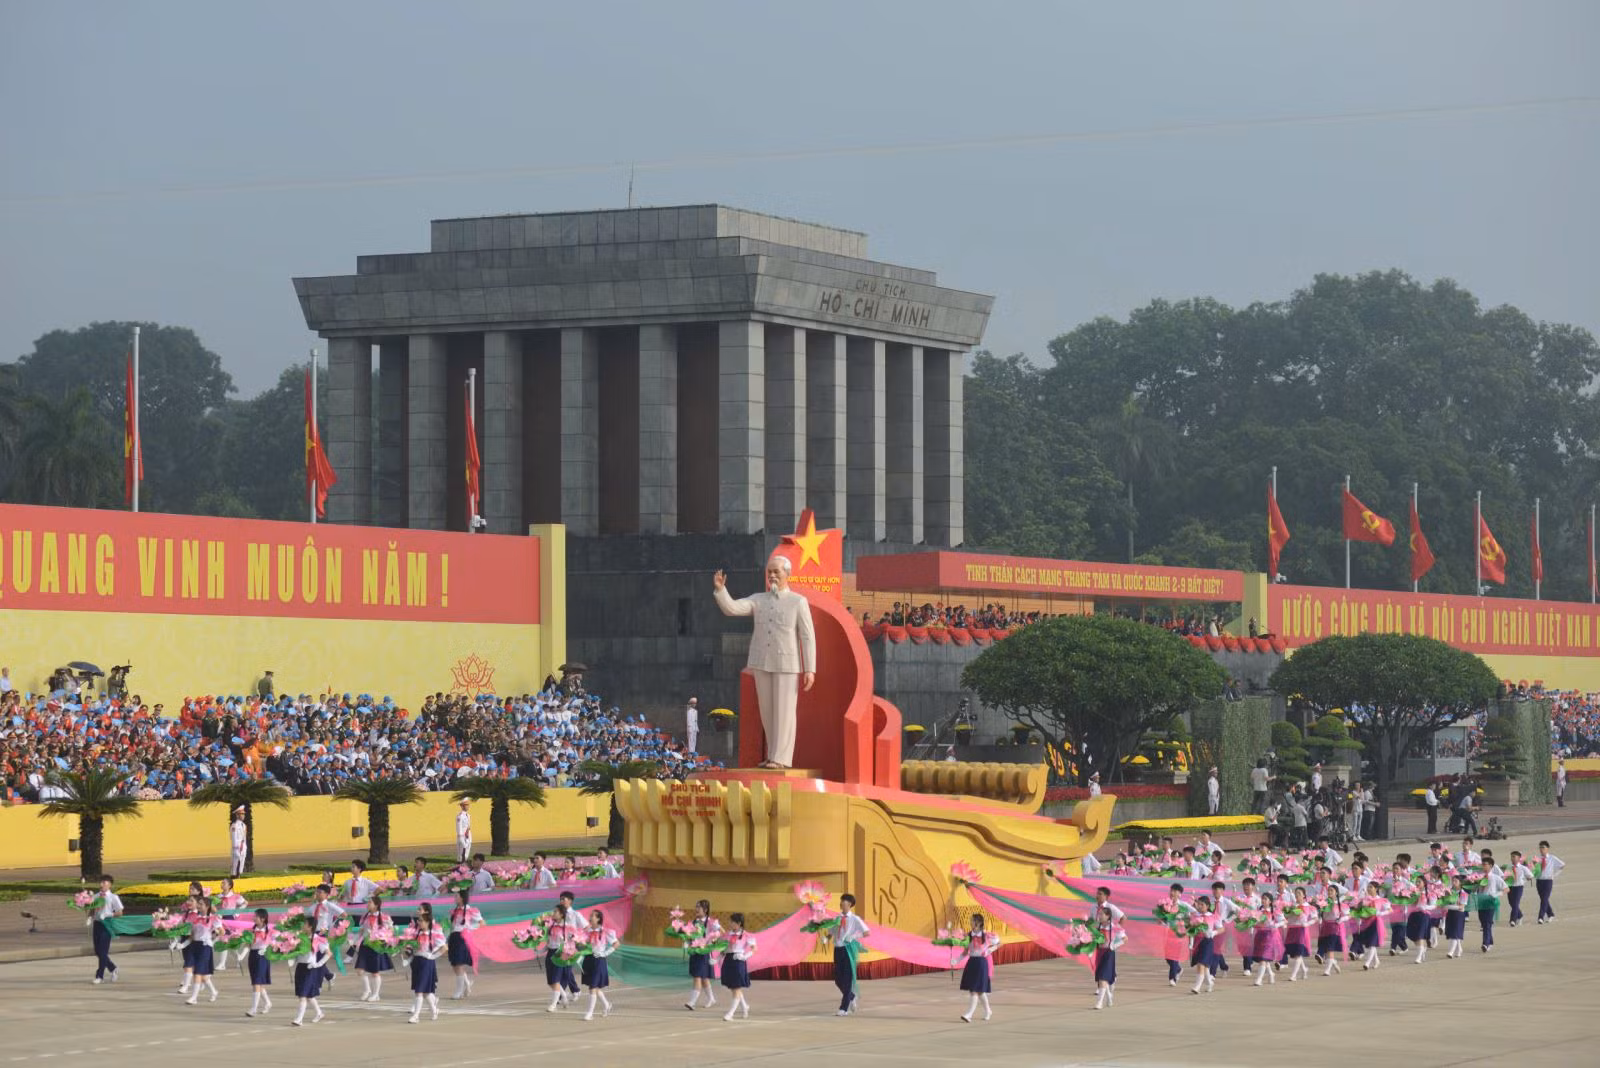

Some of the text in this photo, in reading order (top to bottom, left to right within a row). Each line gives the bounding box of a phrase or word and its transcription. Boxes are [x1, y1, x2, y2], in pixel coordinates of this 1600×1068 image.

[0, 530, 114, 599] UANG
[138, 537, 225, 599] VINH
[247, 535, 342, 604] MUÔN
[362, 540, 428, 607] NĂM
[965, 564, 988, 582] TINH
[1015, 563, 1037, 585] CÁCH
[1282, 593, 1322, 639] NƯỚC
[1461, 600, 1486, 644] CHỦ
[1535, 607, 1562, 653] VIỆT
[1567, 614, 1590, 648] NAM
